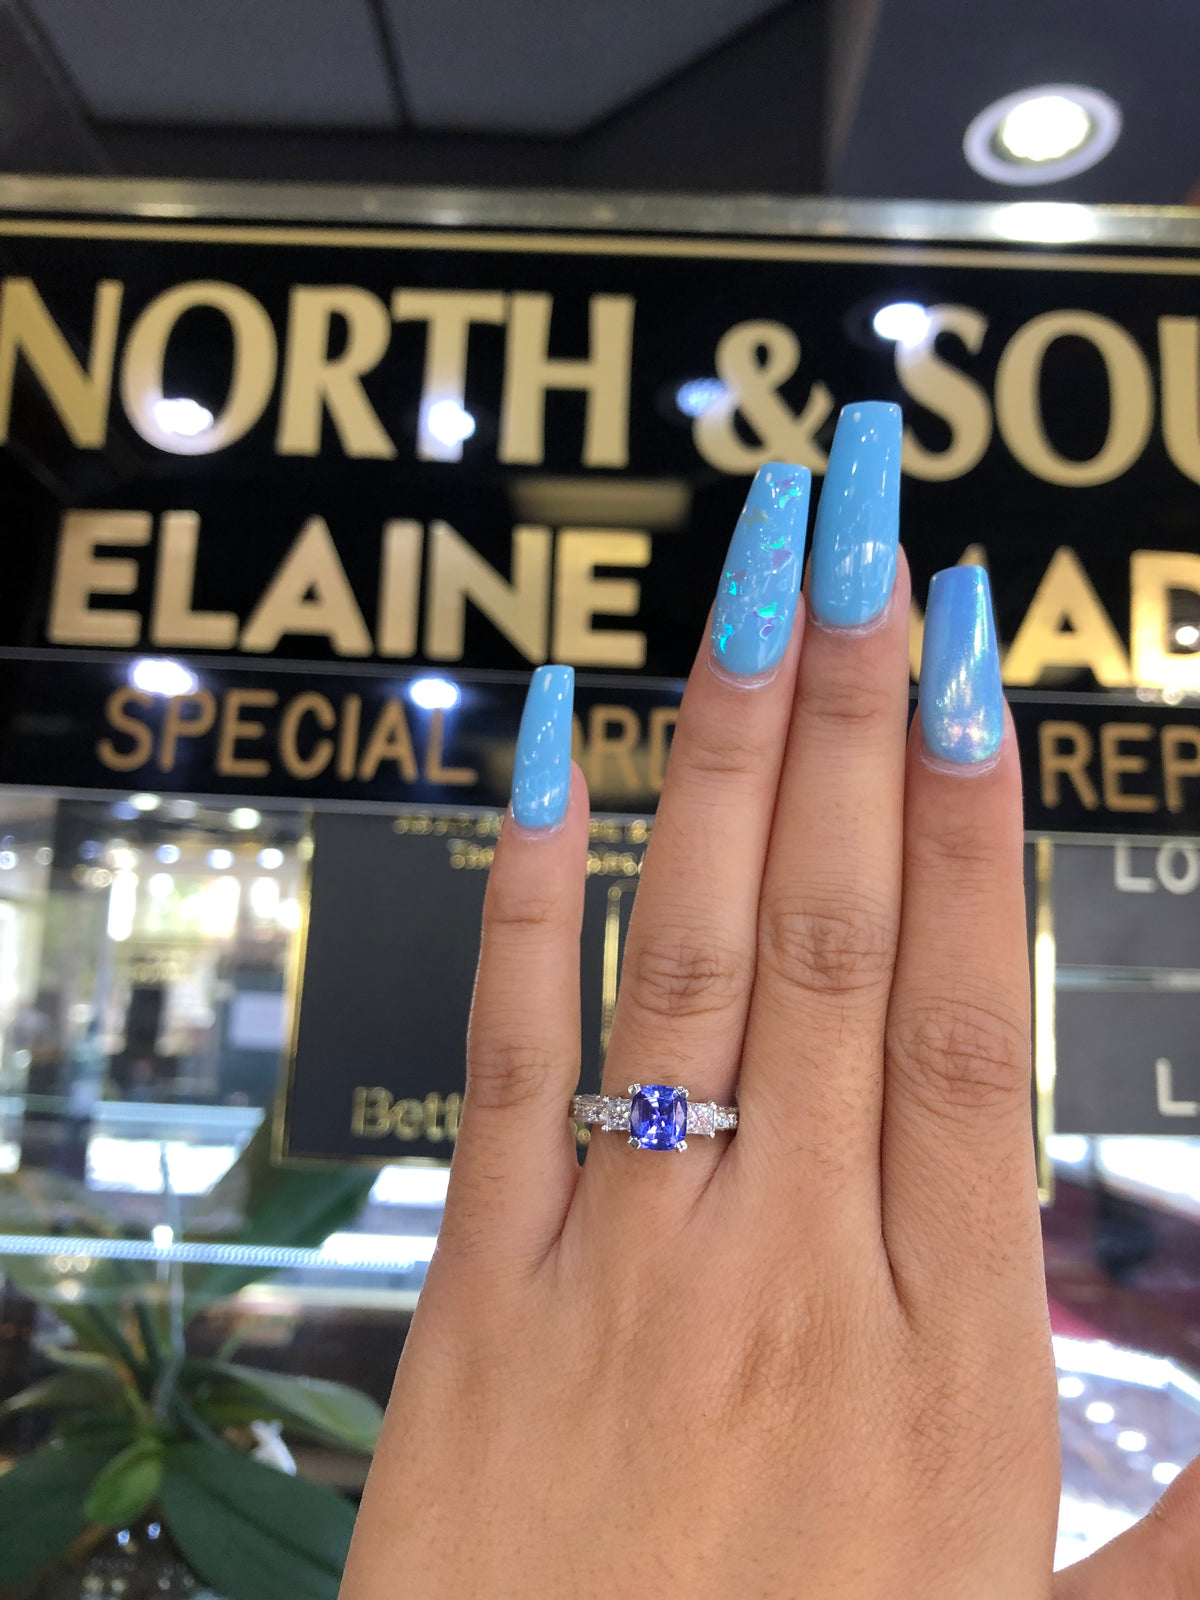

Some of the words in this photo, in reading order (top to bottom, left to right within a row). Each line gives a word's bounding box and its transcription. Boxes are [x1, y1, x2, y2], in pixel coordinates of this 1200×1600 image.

[0, 274, 635, 468] NORTH
[692, 318, 836, 476] &
[46, 508, 652, 668] ELAINE
[910, 542, 1200, 689] AD
[97, 690, 478, 786] SPECIAL
[1037, 719, 1200, 814] REP
